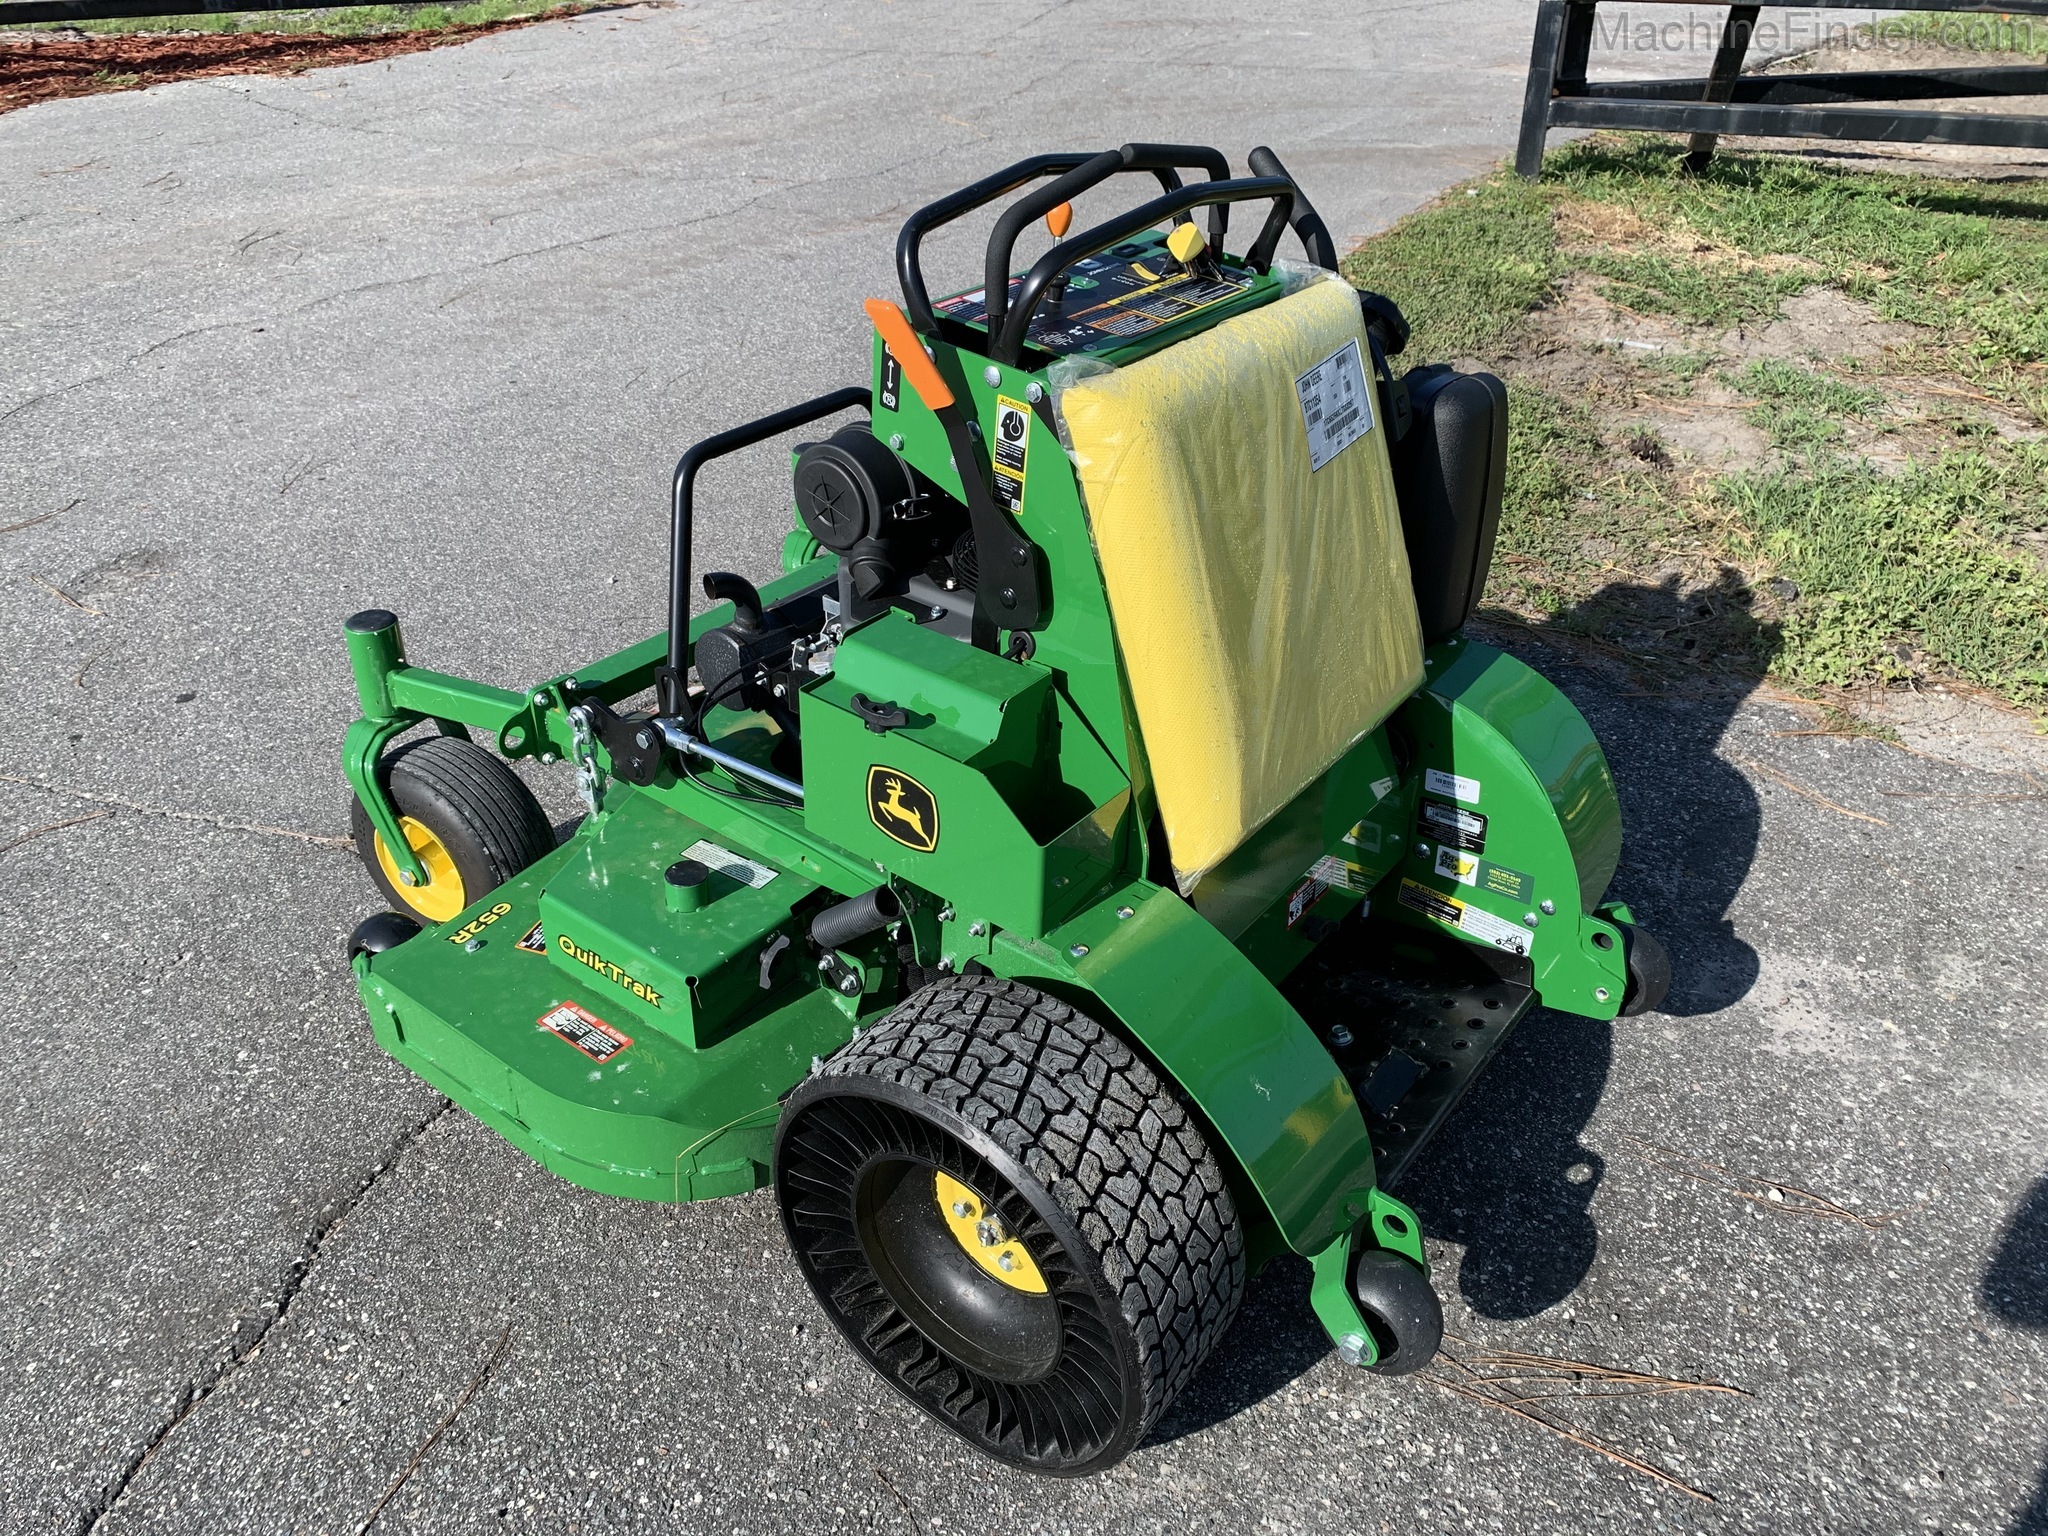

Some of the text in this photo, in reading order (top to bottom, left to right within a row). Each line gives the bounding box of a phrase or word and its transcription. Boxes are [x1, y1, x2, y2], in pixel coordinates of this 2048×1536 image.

[1005, 400, 1028, 411] CAUTION
[446, 902, 512, 945] 652R
[558, 934, 664, 1009] QuikTrak
